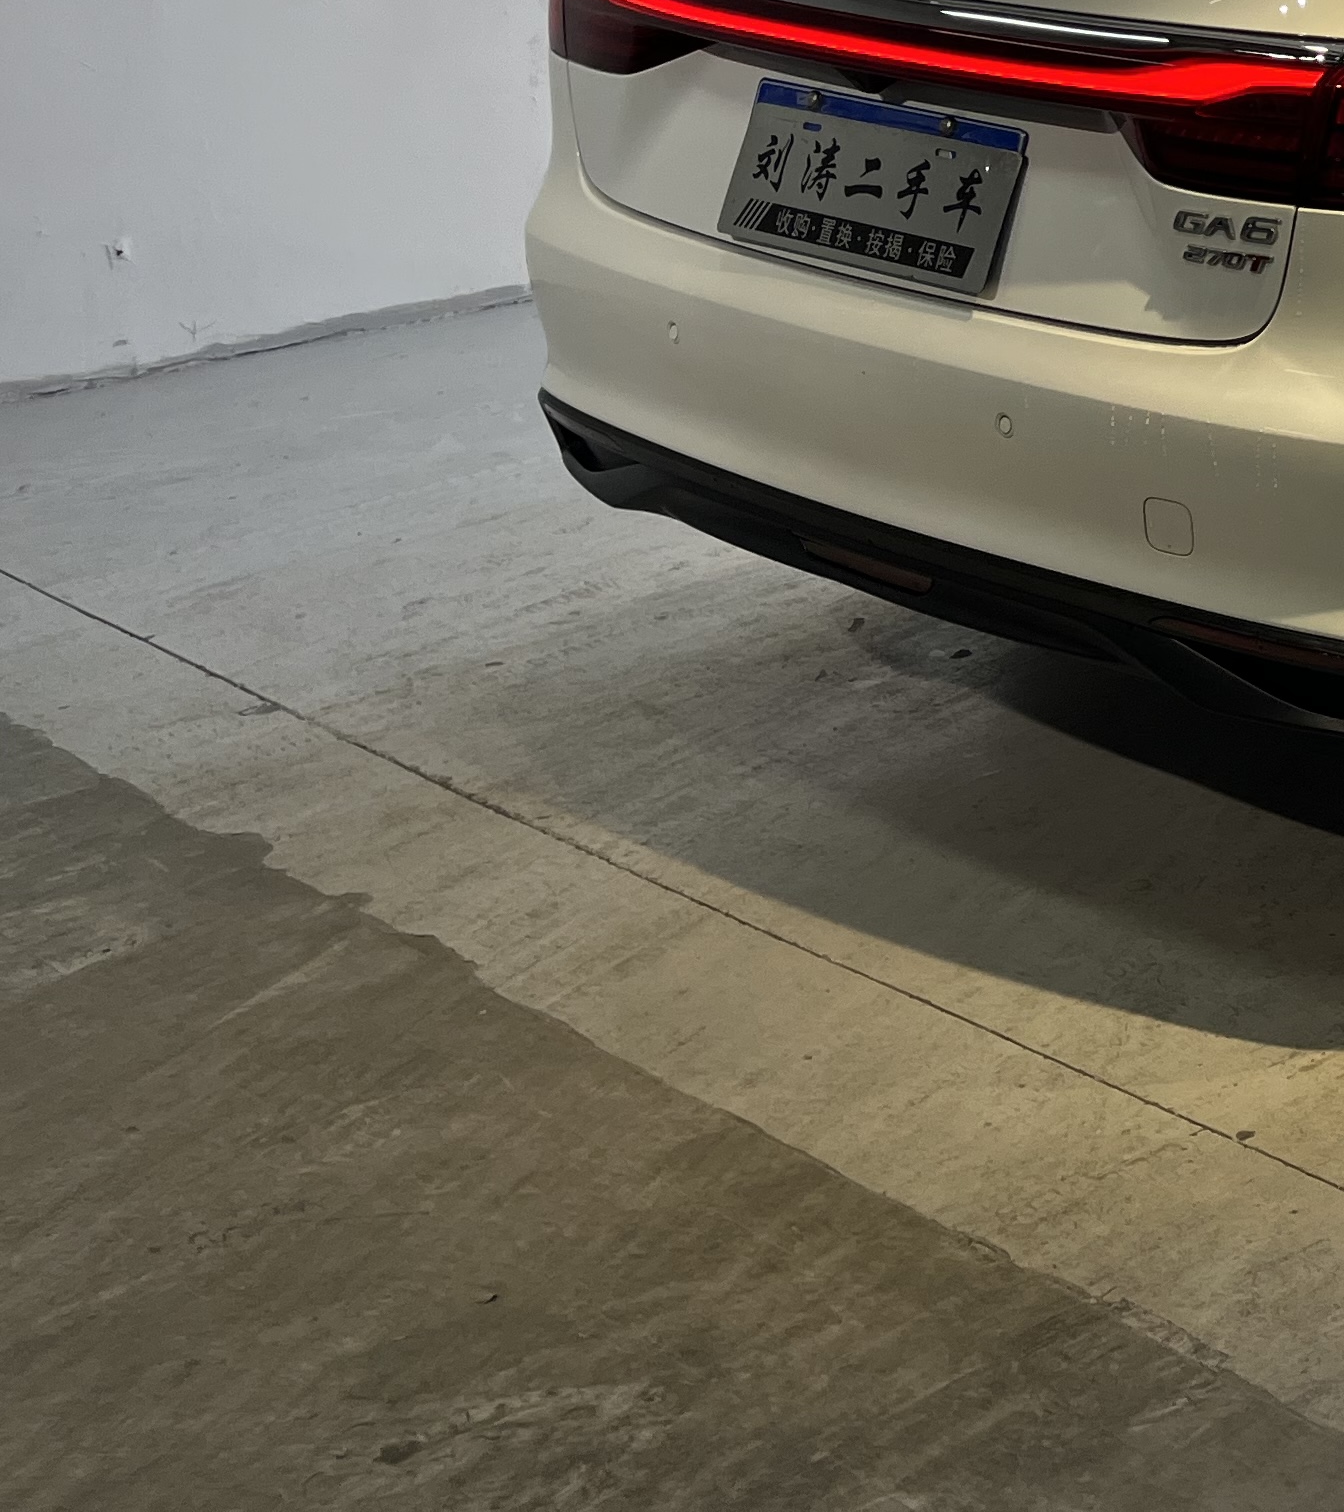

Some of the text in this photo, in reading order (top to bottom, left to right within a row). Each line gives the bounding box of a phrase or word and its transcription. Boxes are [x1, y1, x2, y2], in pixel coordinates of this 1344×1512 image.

[753, 133, 983, 233] 刘涛二手车
[1183, 244, 1274, 274] 270T
